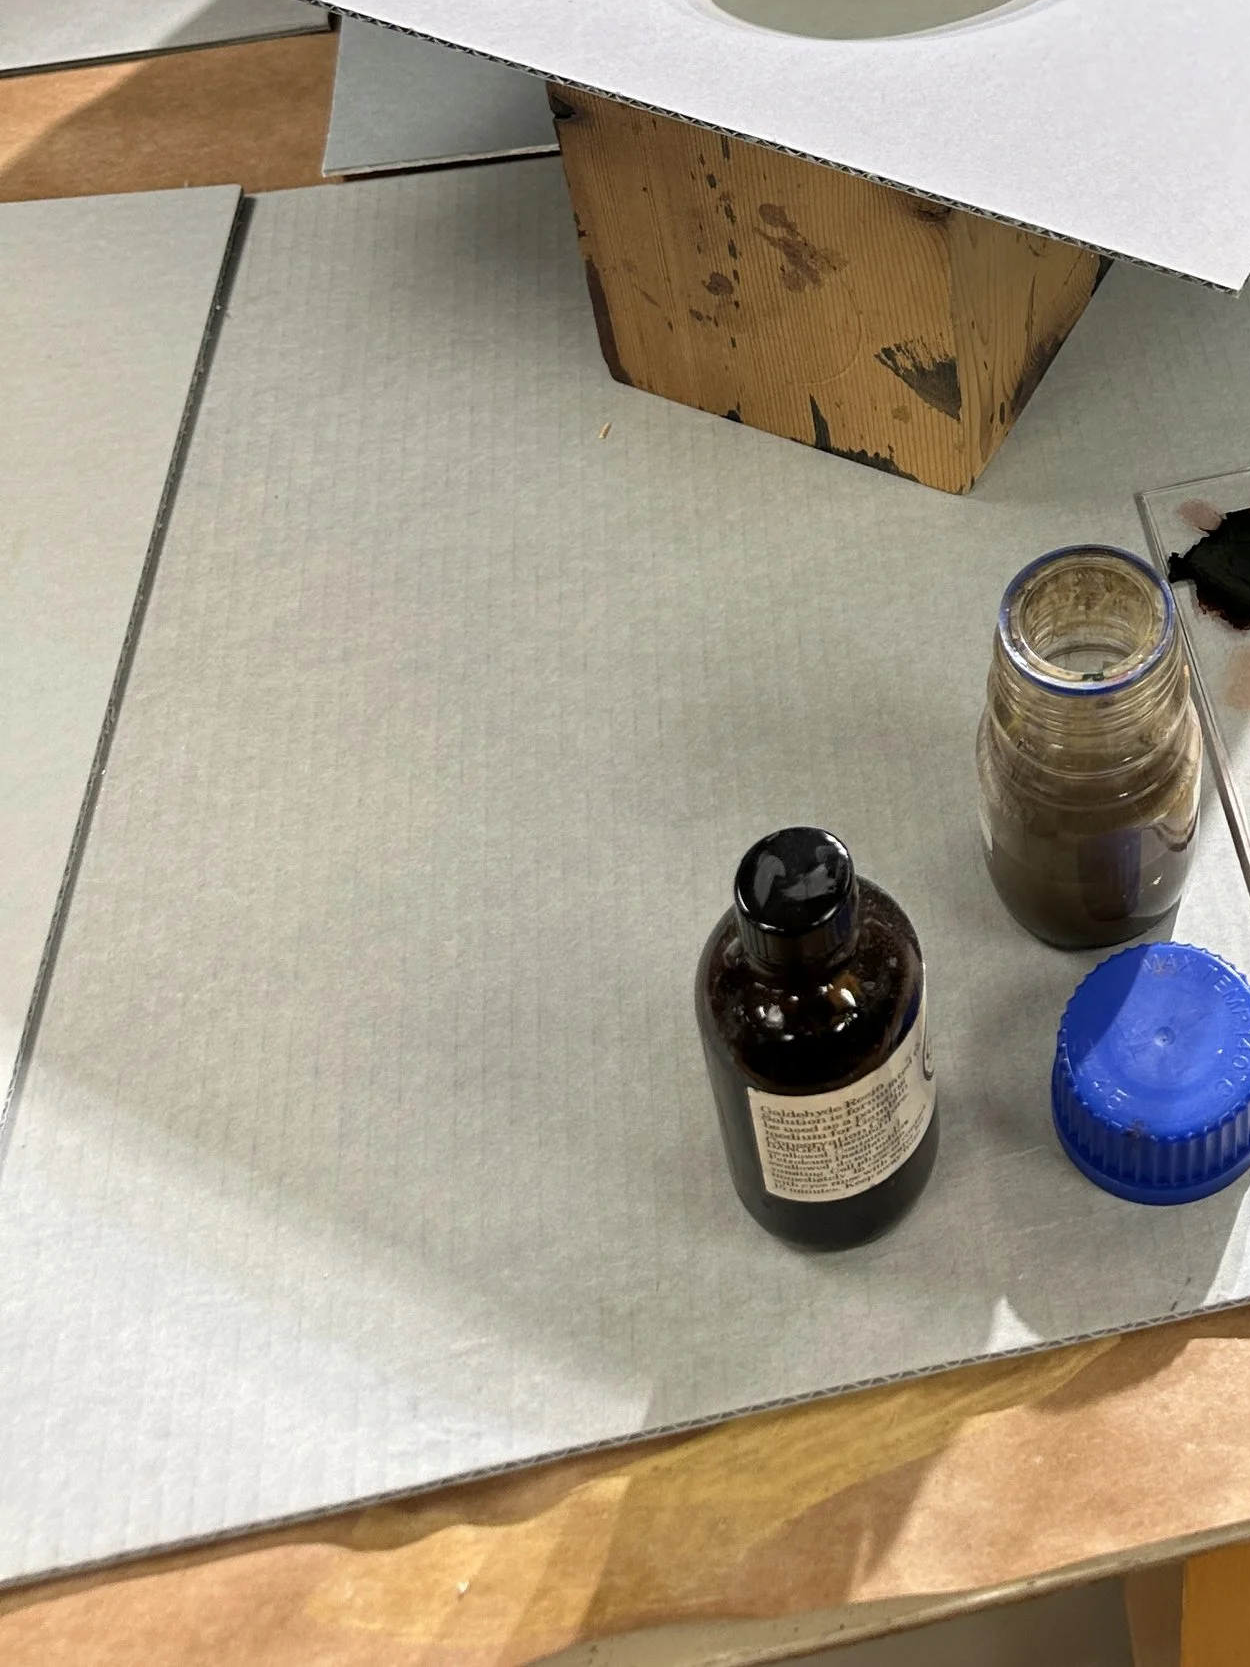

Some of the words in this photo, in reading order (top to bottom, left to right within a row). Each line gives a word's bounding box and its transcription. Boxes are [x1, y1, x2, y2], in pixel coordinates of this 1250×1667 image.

[1142, 952, 1198, 977] MAX
[759, 1104, 842, 1118] Galdehyde
[843, 1082, 884, 1108] Resin
[760, 1112, 827, 1125] Solution
[762, 1119, 780, 1130] be
[783, 1124, 819, 1133] used
[764, 1129, 827, 1141] medium
[829, 1125, 851, 1137] for
